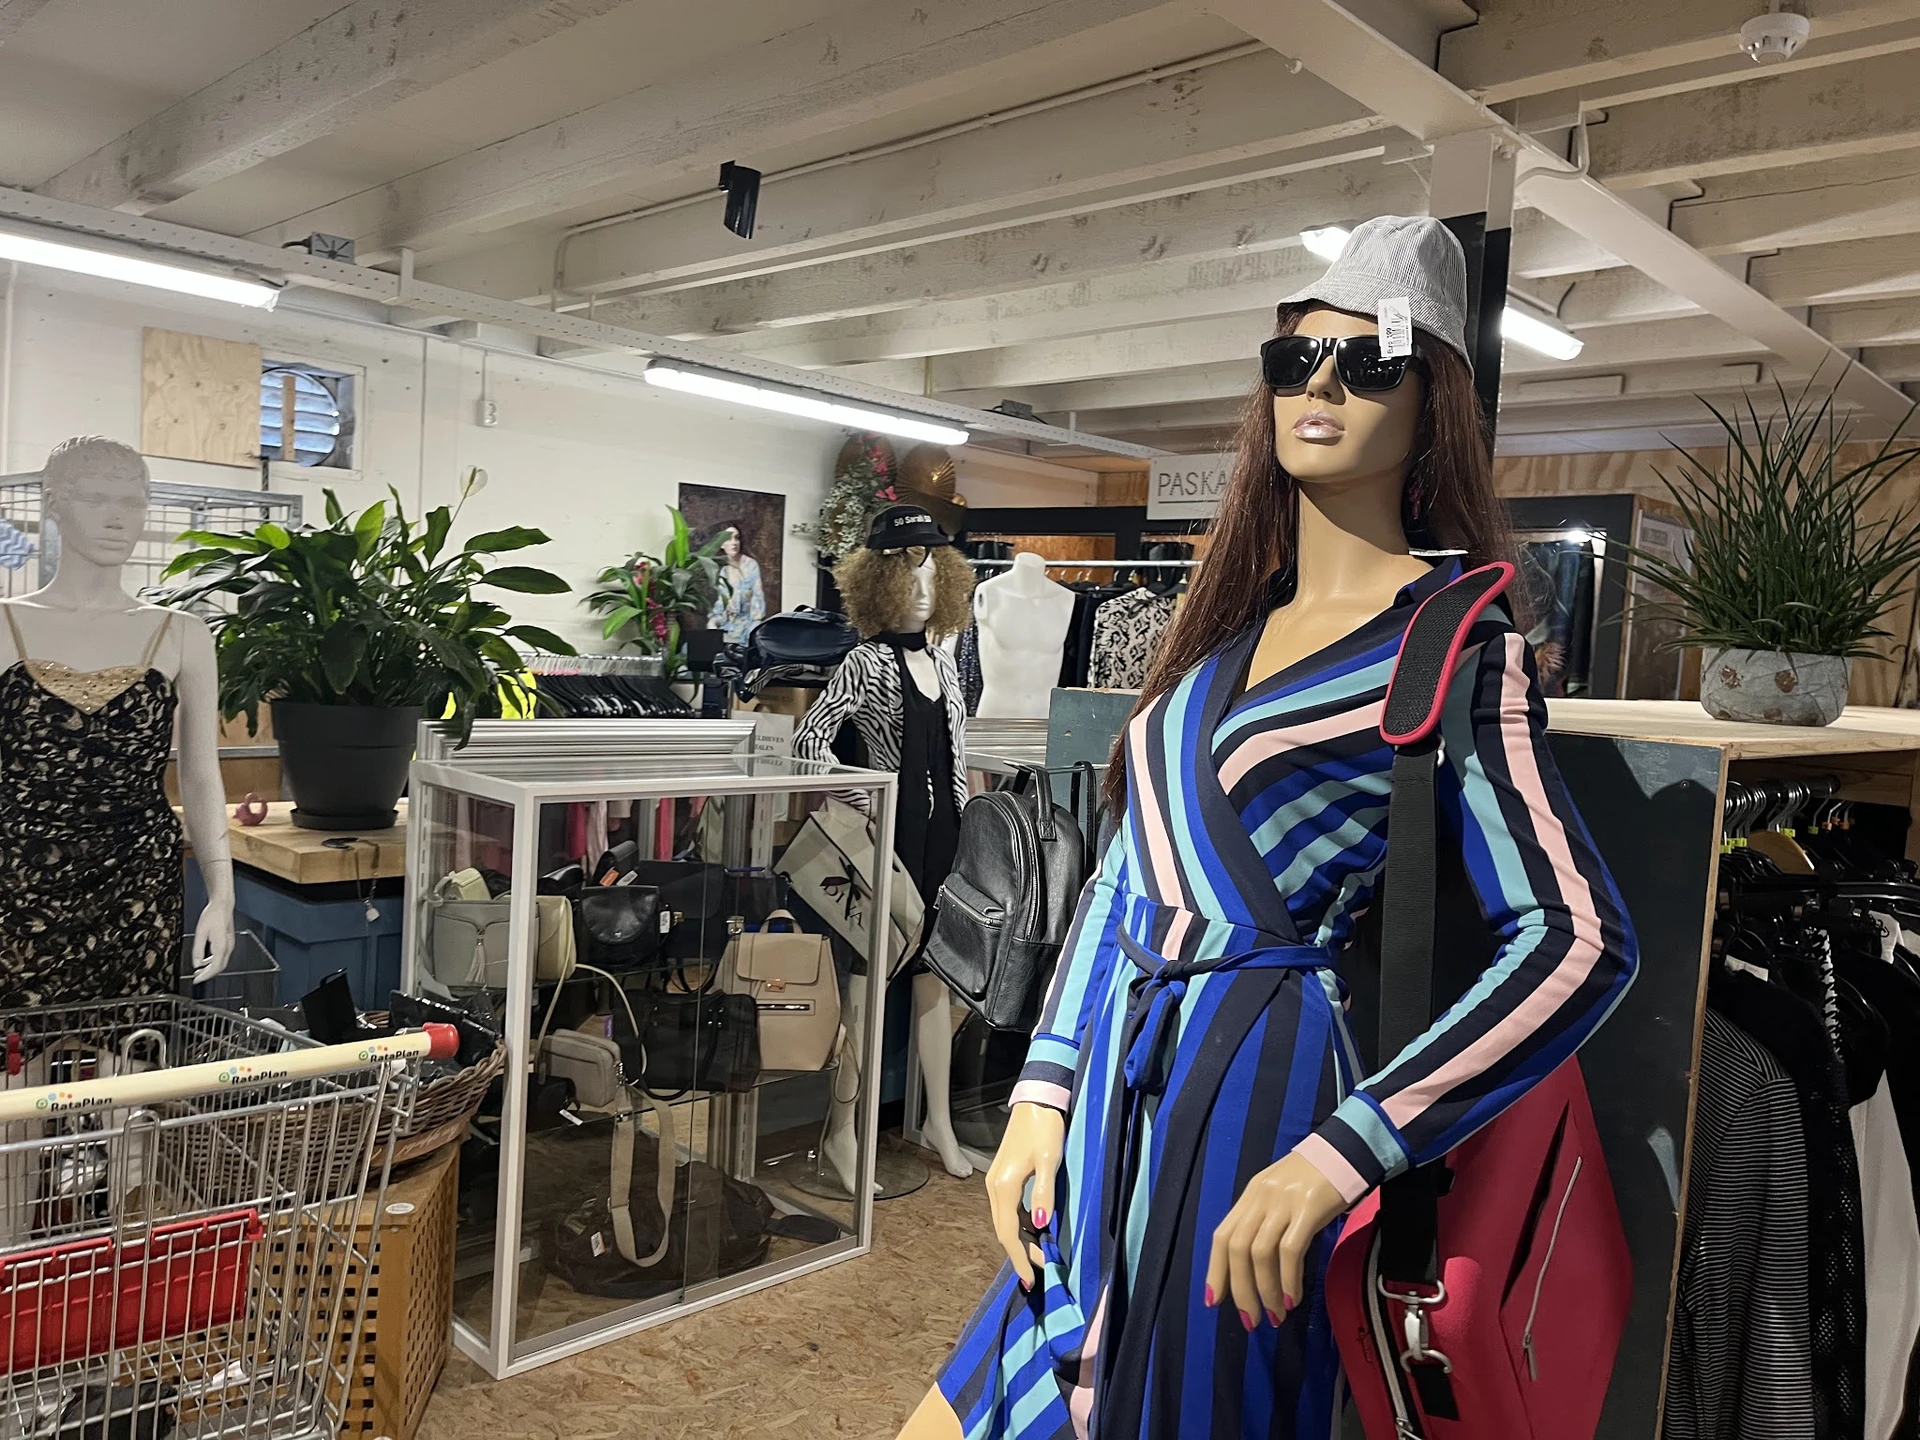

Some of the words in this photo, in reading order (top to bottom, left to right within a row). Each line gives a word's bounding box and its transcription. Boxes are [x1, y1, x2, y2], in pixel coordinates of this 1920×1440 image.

[893, 517, 905, 527] 50
[824, 885, 865, 931] DIA
[371, 1050, 419, 1063] RataPlan
[232, 1070, 287, 1085] RataPlan
[51, 1097, 112, 1112] RataPlan
